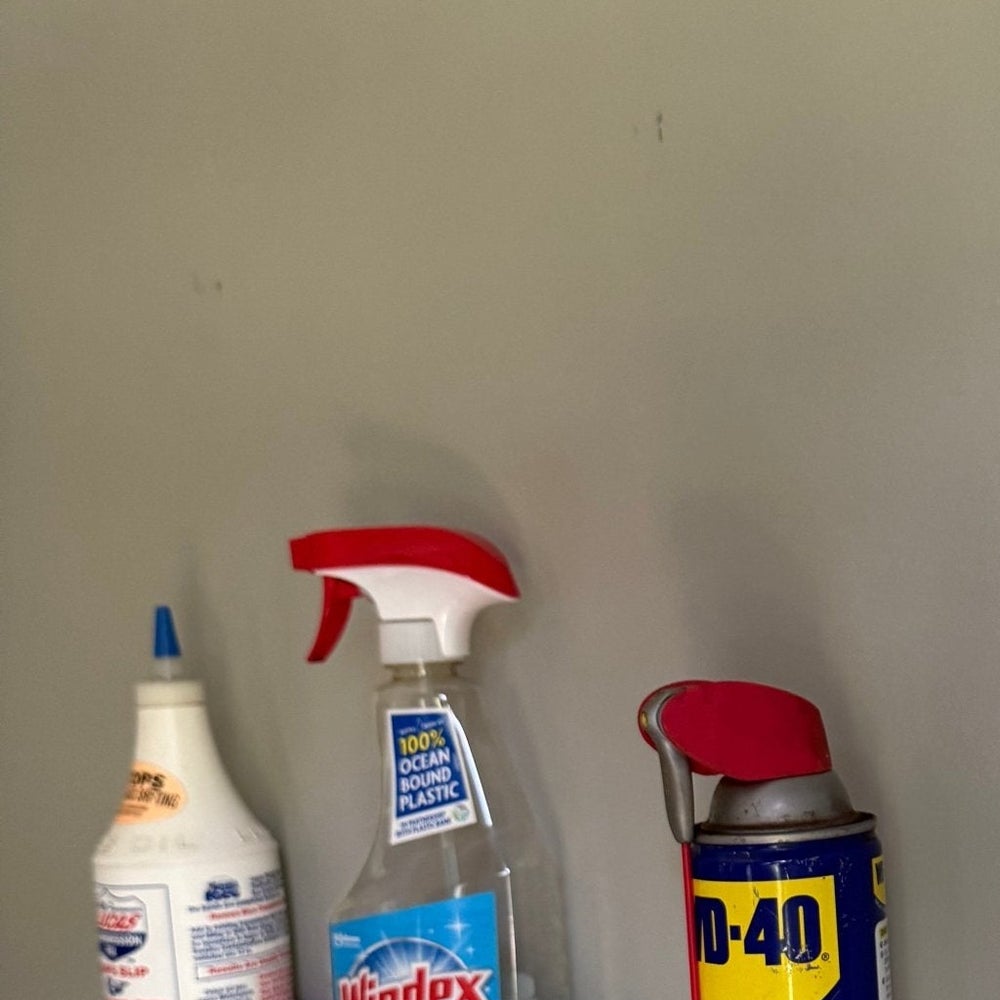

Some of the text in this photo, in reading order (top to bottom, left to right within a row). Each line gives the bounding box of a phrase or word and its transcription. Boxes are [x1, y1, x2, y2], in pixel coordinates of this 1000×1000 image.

[399, 728, 446, 755] 100%
[400, 747, 450, 775] OCEAN
[130, 771, 166, 788] OPS
[401, 767, 452, 793] BOUND
[400, 781, 460, 812] PLASTIC
[695, 895, 822, 966] D-40
